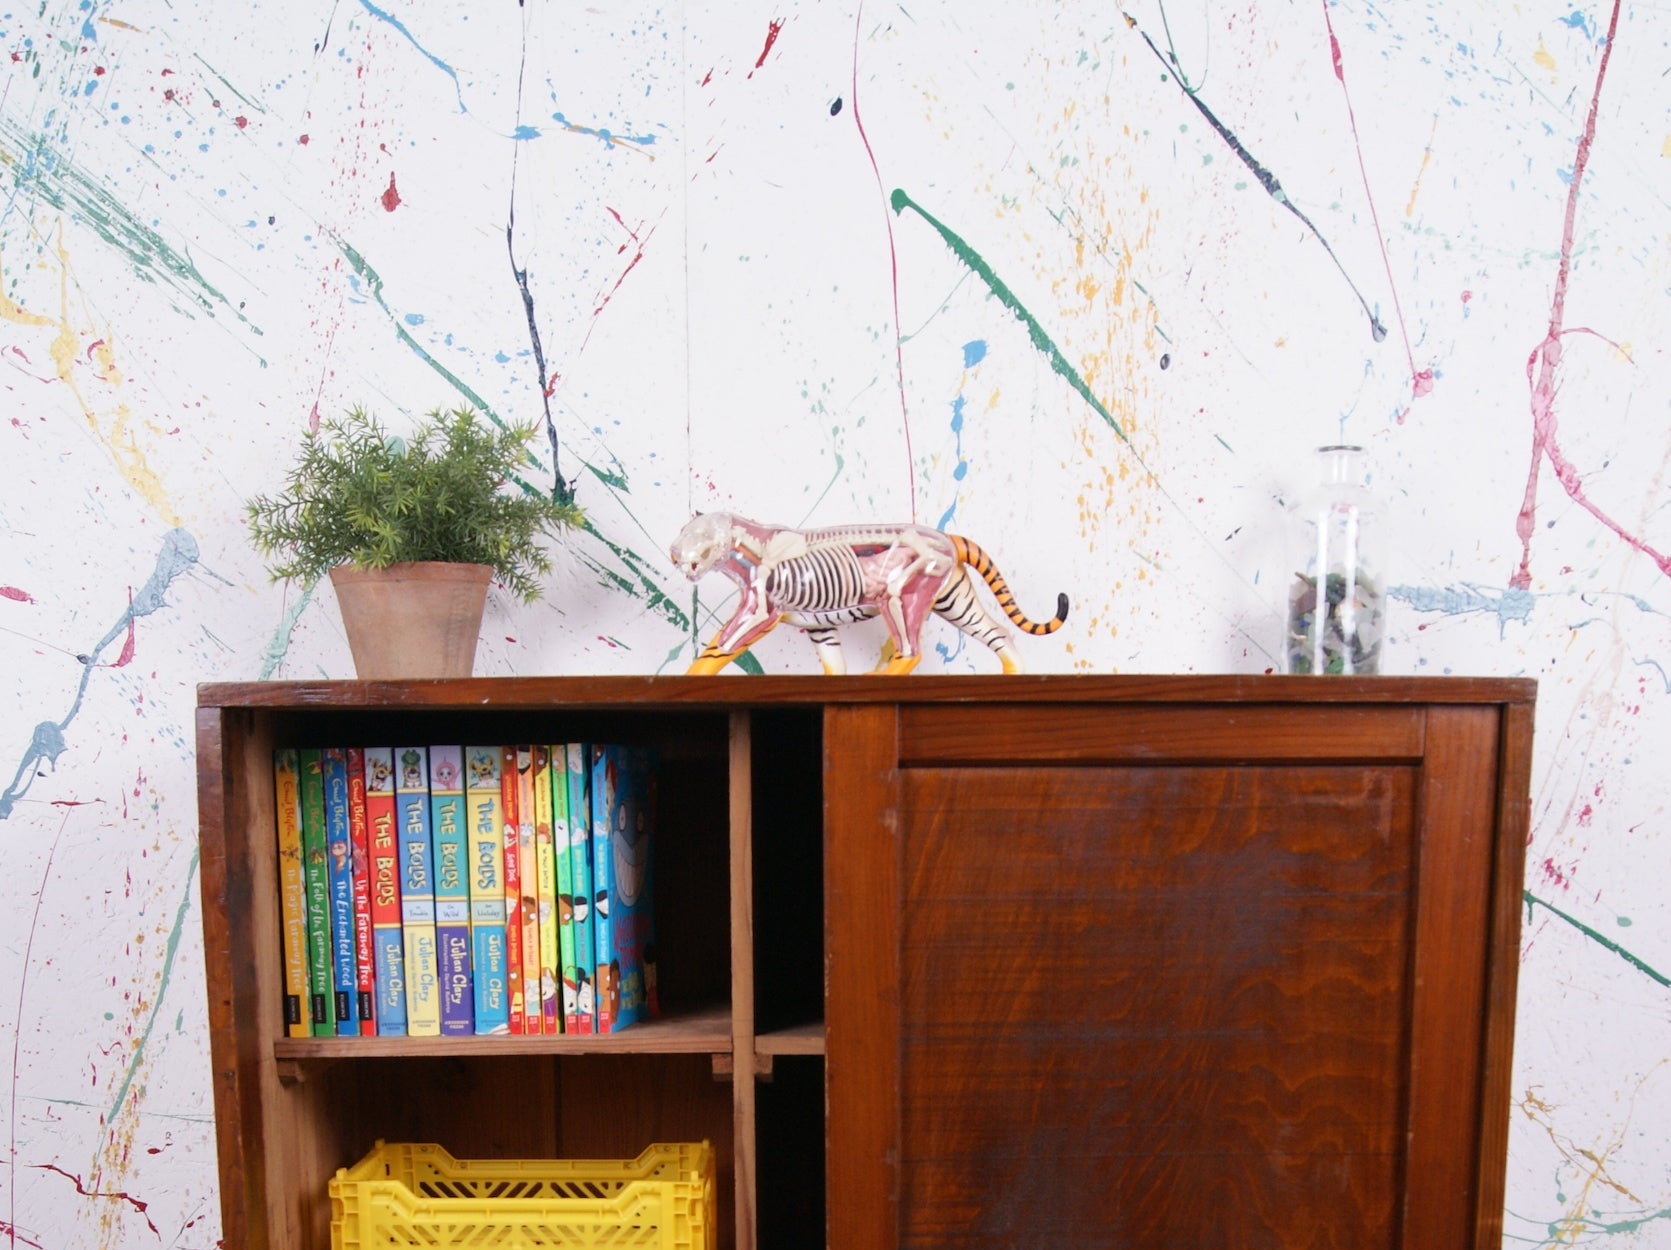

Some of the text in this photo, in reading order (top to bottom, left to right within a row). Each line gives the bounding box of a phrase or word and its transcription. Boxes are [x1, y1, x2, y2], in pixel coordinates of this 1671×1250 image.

[285, 807, 295, 838] Blyton
[332, 778, 344, 837] Enid Blyton
[352, 778, 364, 837] Enid Blyton
[375, 811, 395, 906] THE BOLDS
[407, 798, 426, 890] THE BOLDS
[440, 799, 459, 890] THE BOLDS
[478, 798, 496, 890] THE BOLDS
[314, 882, 324, 903] Folk
[356, 879, 367, 891] Up
[311, 903, 324, 914] of
[290, 918, 302, 965] Faraway
[314, 930, 325, 969] Faraway
[337, 880, 352, 986] The Enchanted Wood
[357, 913, 369, 961] Faraway
[387, 944, 401, 977] Julian
[419, 937, 433, 970] Julian
[451, 937, 467, 972] Julian
[488, 934, 502, 972] Julian
[293, 968, 303, 991] Tree
[318, 971, 327, 992] Tree
[360, 964, 371, 986] Tree
[420, 974, 434, 1003] Clary
[452, 974, 468, 1005] Clary
[389, 979, 402, 1008] Clary
[488, 978, 502, 1010] Clary
